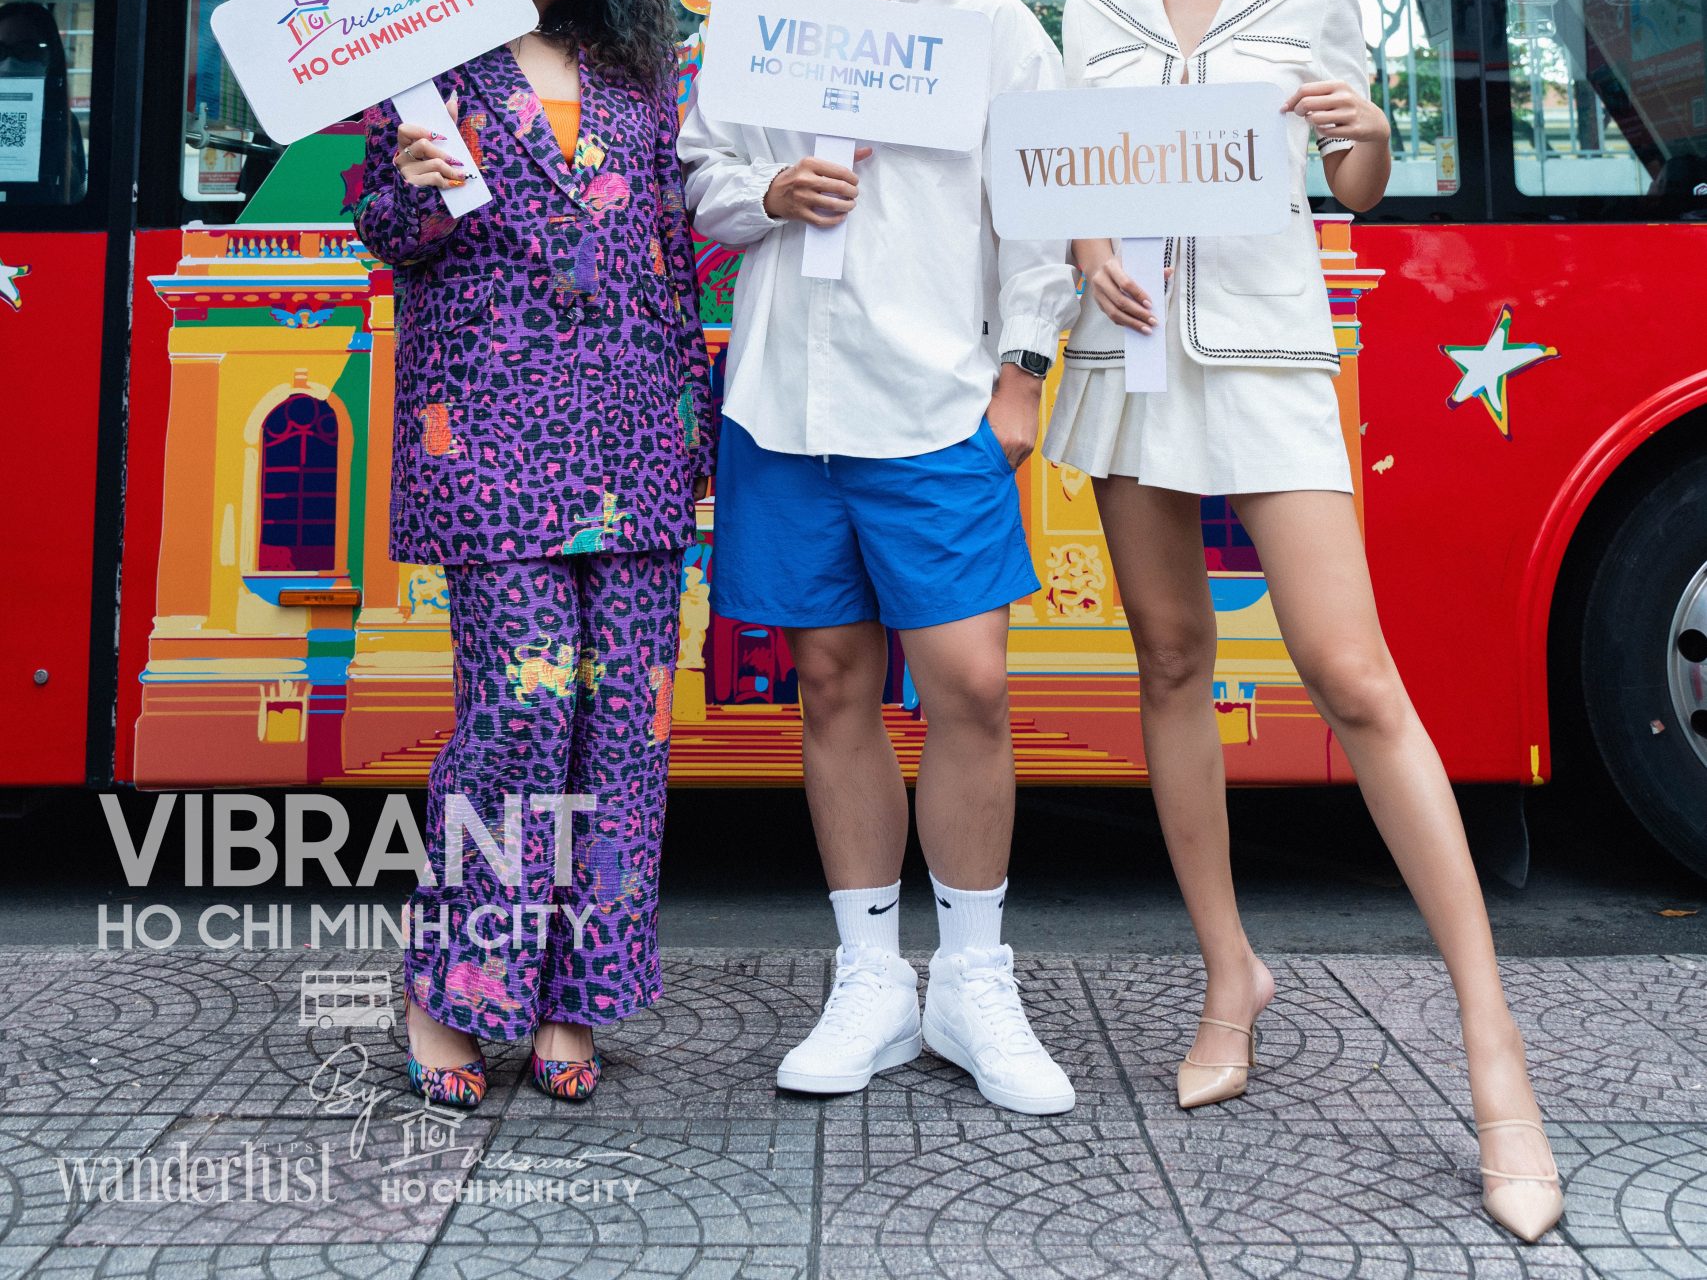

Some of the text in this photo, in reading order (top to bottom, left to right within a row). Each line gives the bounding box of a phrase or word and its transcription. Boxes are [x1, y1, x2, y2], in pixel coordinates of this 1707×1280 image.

[292, 56, 329, 85] HO
[331, 37, 372, 67] CHI
[371, 10, 428, 50] MINH
[758, 15, 944, 71] VIBRANT
[750, 55, 940, 95] HO CHI MINH CITY
[1015, 128, 1264, 188] wanderlust
[1192, 129, 1240, 140] TIPS
